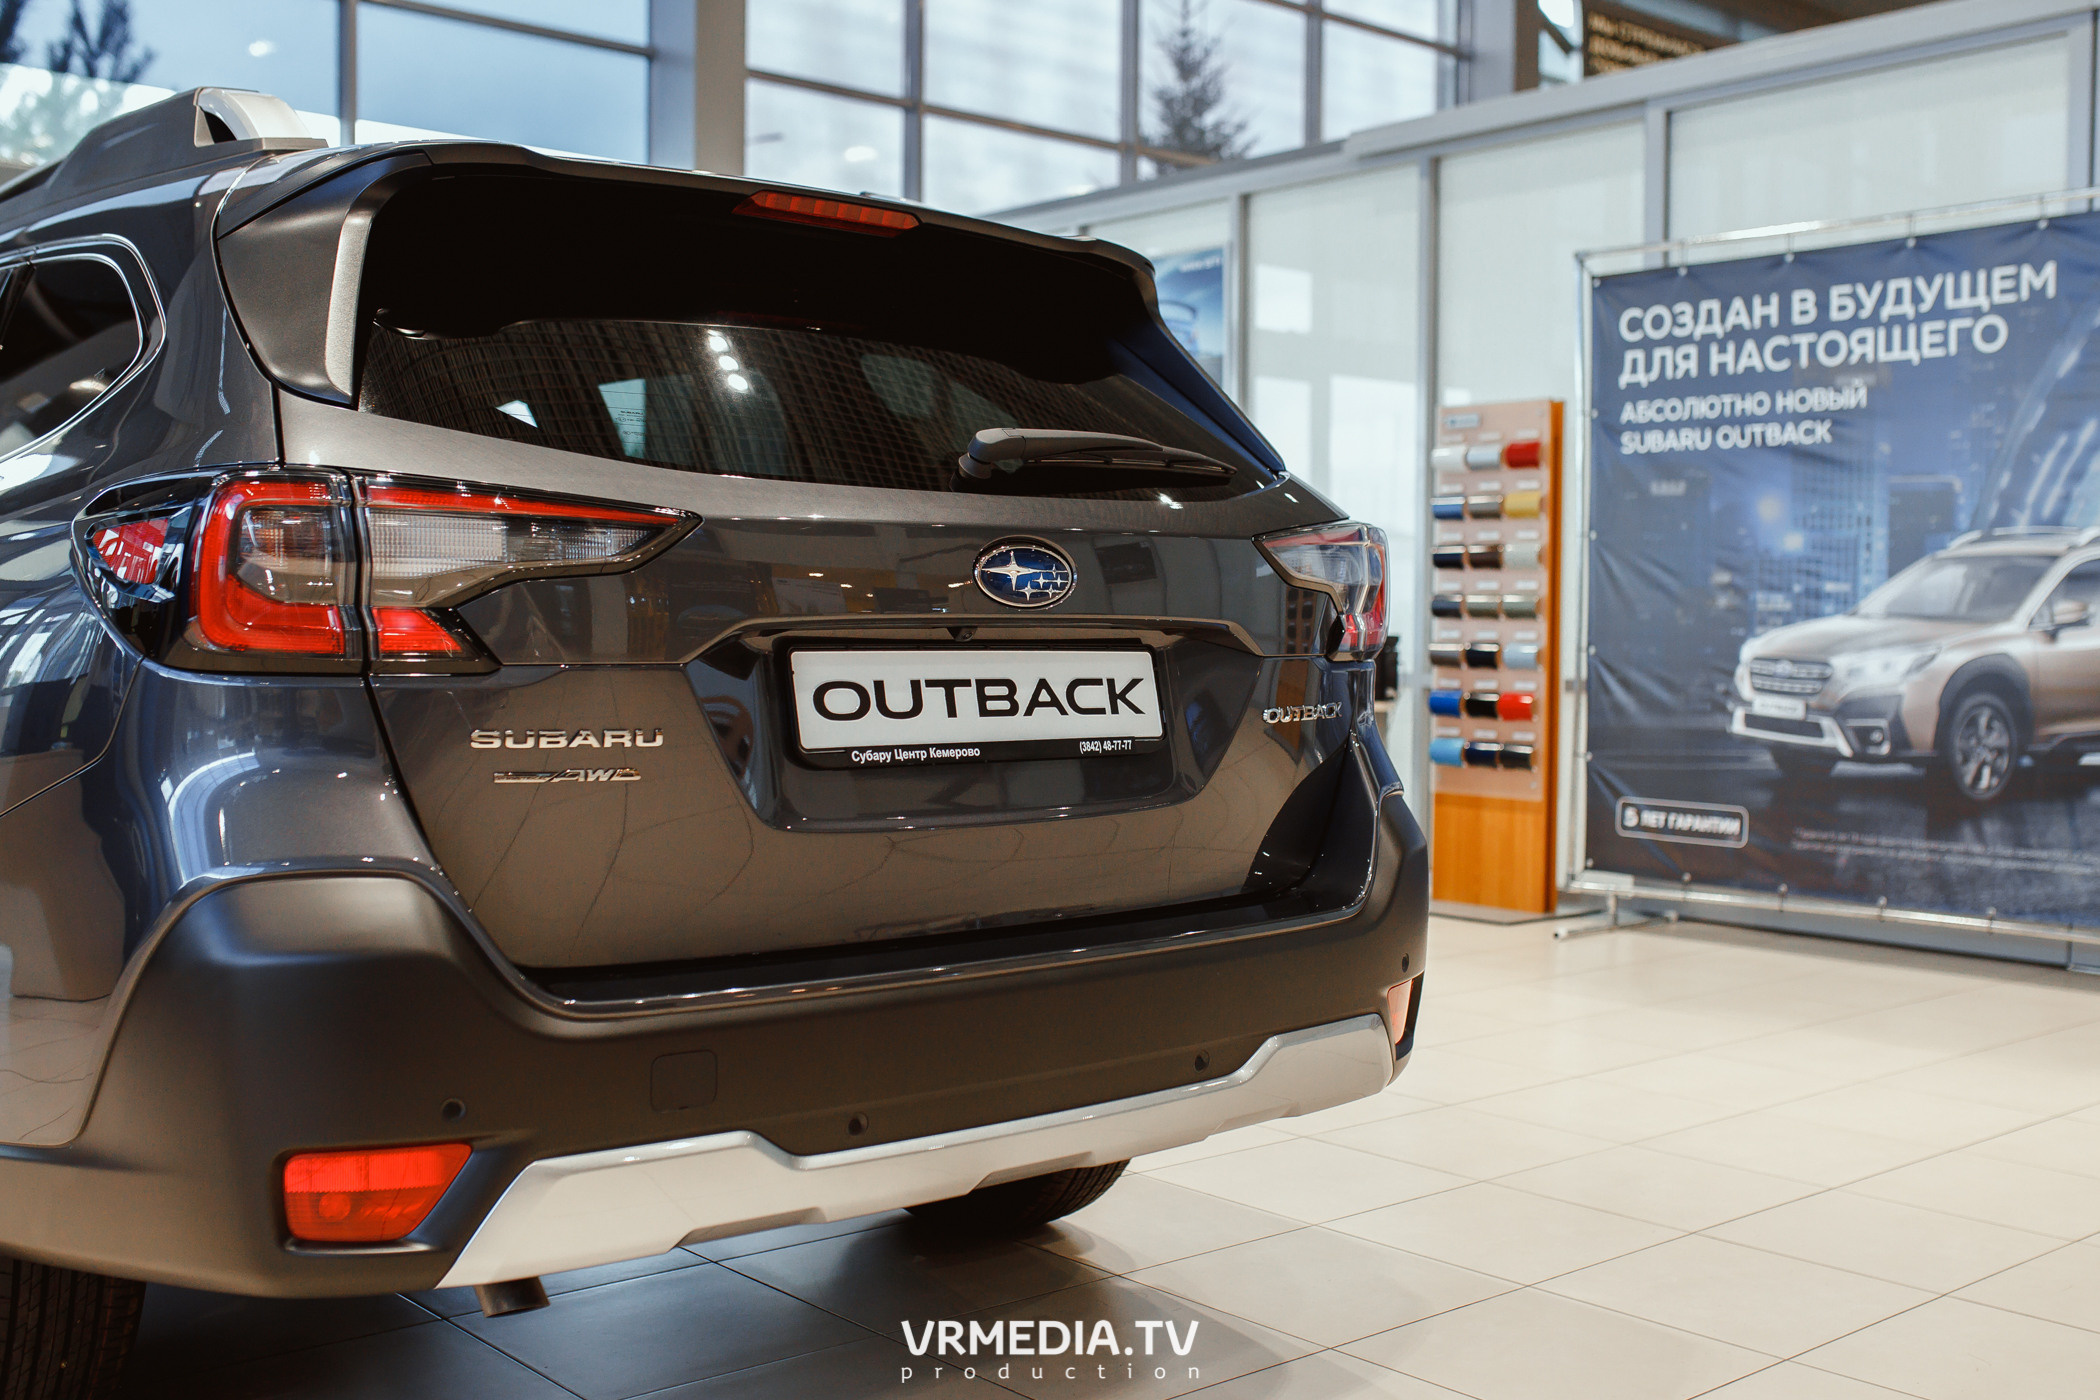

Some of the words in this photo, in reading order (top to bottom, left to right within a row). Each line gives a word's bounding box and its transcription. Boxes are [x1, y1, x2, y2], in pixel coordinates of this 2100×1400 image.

[1618, 291, 1779, 342] СОЗДАН
[1791, 288, 1818, 326] В
[1829, 260, 2057, 323] БУДУЩЕМ
[1618, 343, 1699, 390] ДЛЯ
[1709, 313, 2009, 377] НАСТОЯЩЕГО
[1619, 391, 1771, 424] АБСОЛЮТНО
[1775, 380, 1868, 415] НОВЫЙ
[1620, 426, 1712, 455] SUBARU
[1716, 419, 1833, 449] OUTBACK
[812, 678, 1146, 722] OUTBACK
[1262, 701, 1343, 724] OUTBACK
[470, 728, 664, 749] SUBARU
[1080, 740, 1102, 754] (3842)
[1103, 740, 1132, 751] 48-77-77
[851, 750, 892, 764] Субару
[894, 748, 927, 761] Центр
[929, 747, 980, 759] Кемерово
[550, 768, 641, 782] AWD
